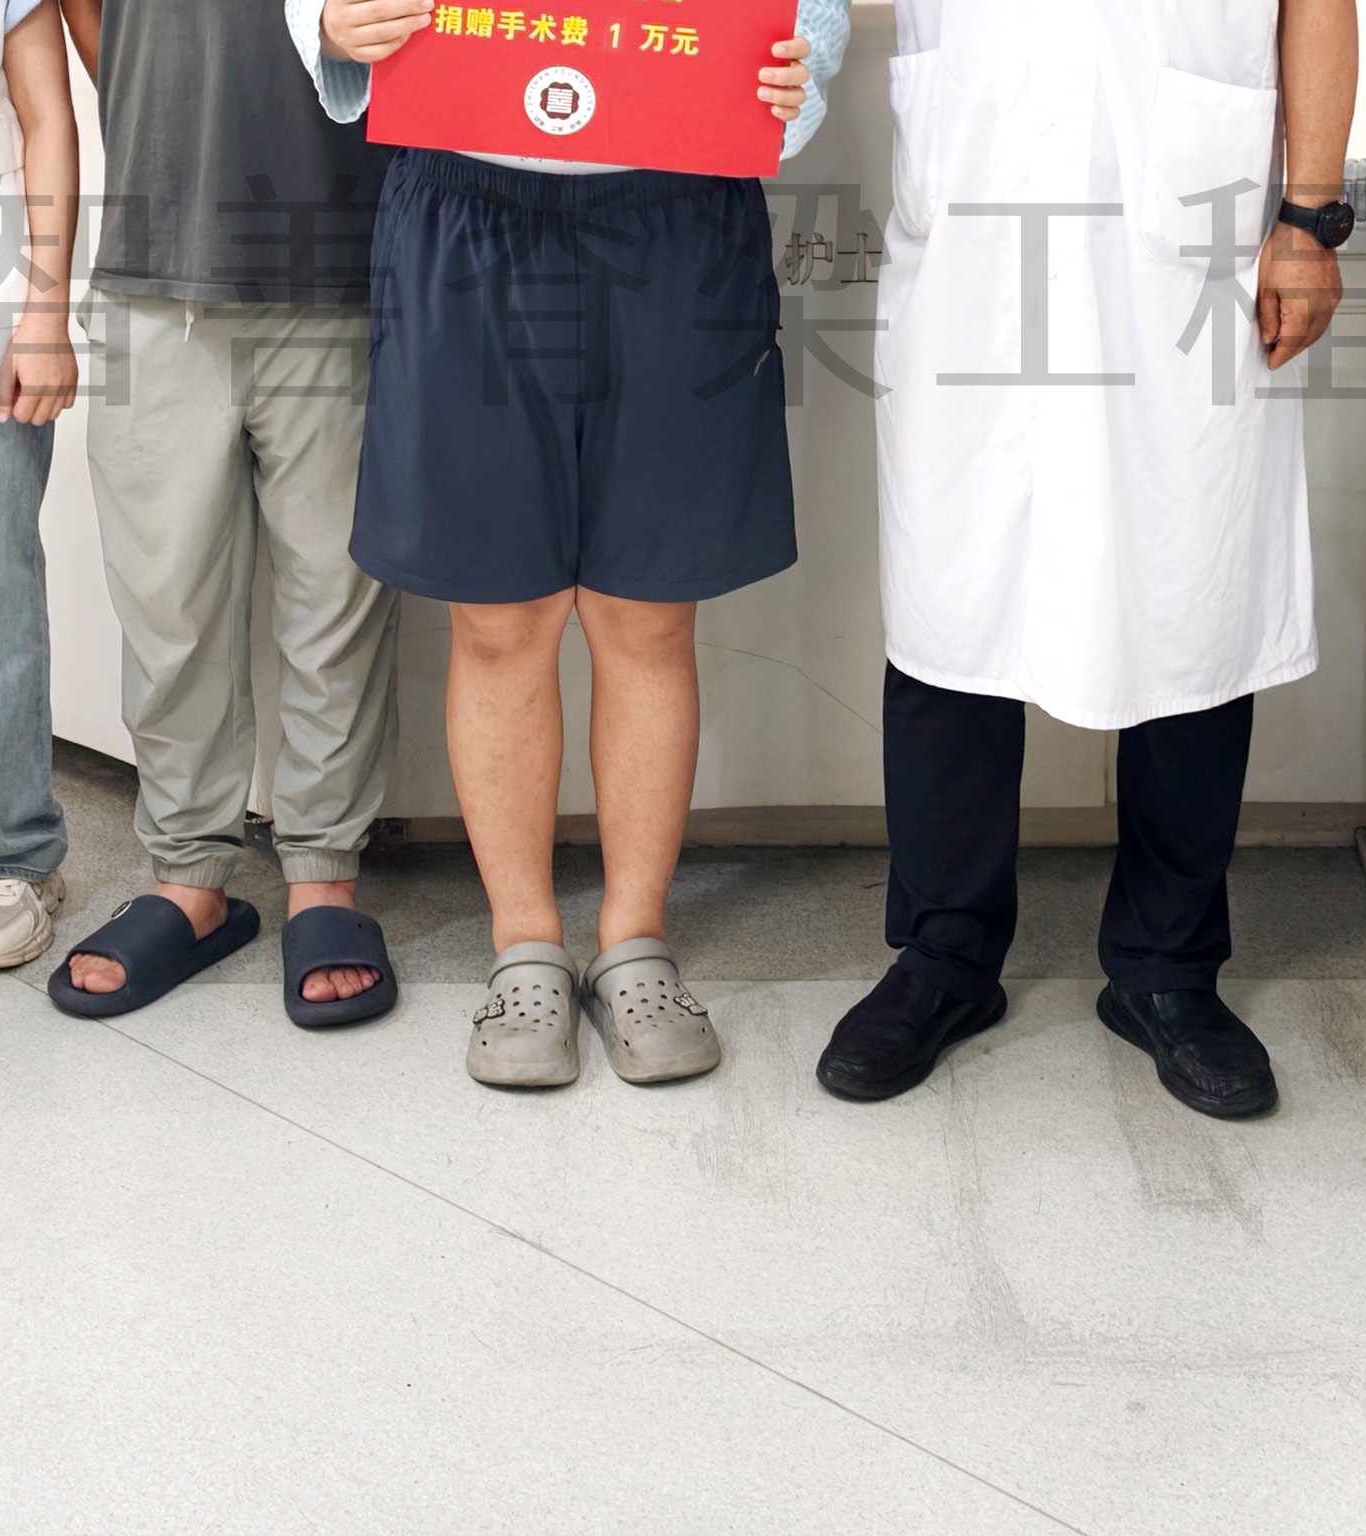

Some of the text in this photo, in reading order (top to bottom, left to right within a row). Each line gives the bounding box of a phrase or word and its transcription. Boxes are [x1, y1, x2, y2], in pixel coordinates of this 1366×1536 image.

[435, 3, 700, 55] 捐赠手术费 1 万元
[785, 232, 883, 286] 护士
